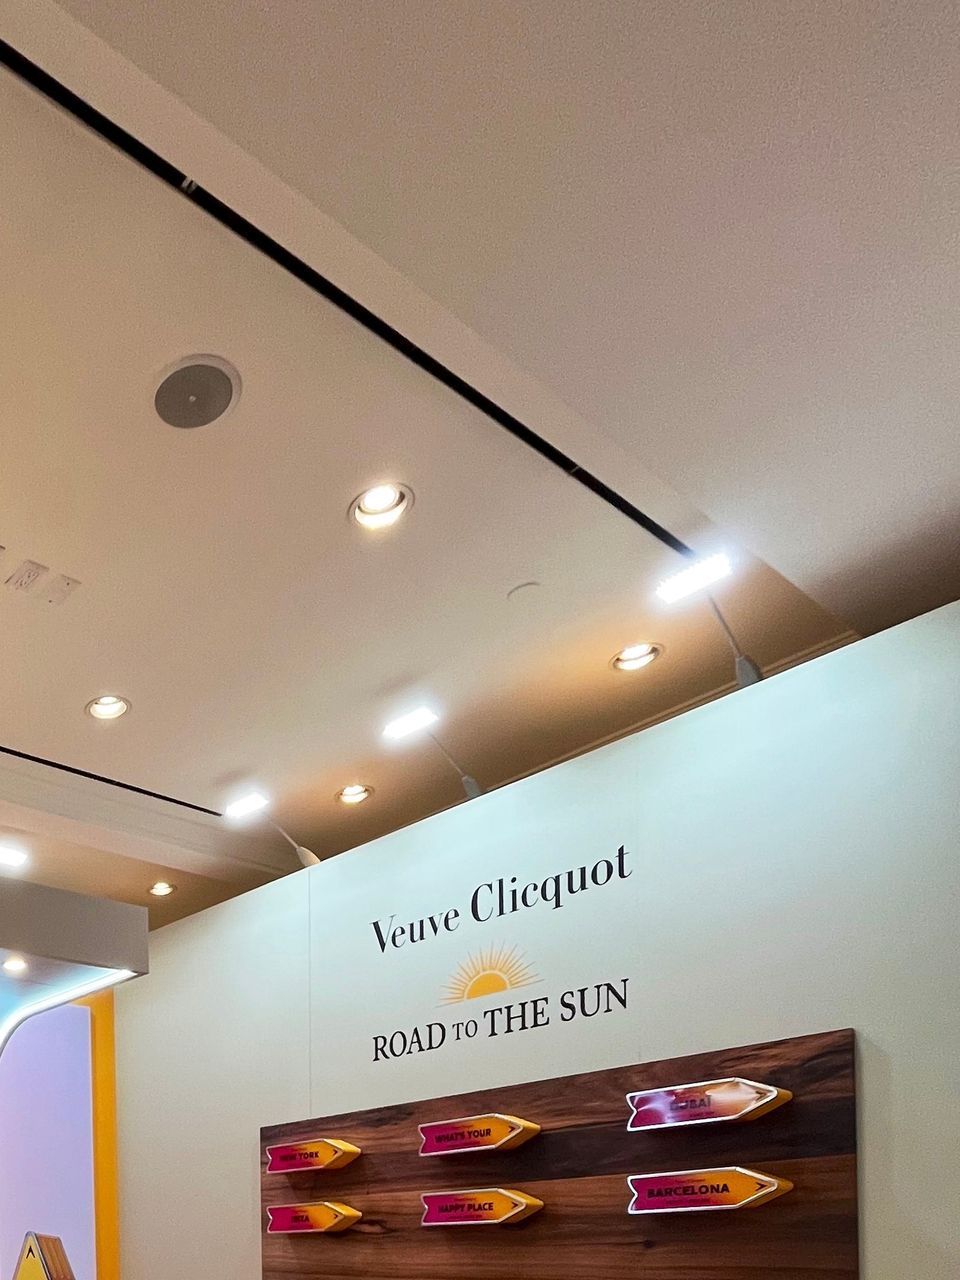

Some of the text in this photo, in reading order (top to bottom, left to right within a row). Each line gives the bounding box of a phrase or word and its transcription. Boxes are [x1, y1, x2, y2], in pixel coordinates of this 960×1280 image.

[369, 844, 633, 953] Veuve Clicquot
[372, 978, 630, 1062] ROAD TO THE SUN
[467, 1128, 492, 1139] YOUR
[298, 1151, 320, 1160] YORK
[647, 1184, 730, 1199] BARCELONA
[438, 1202, 494, 1214] HAPPY PLACE
